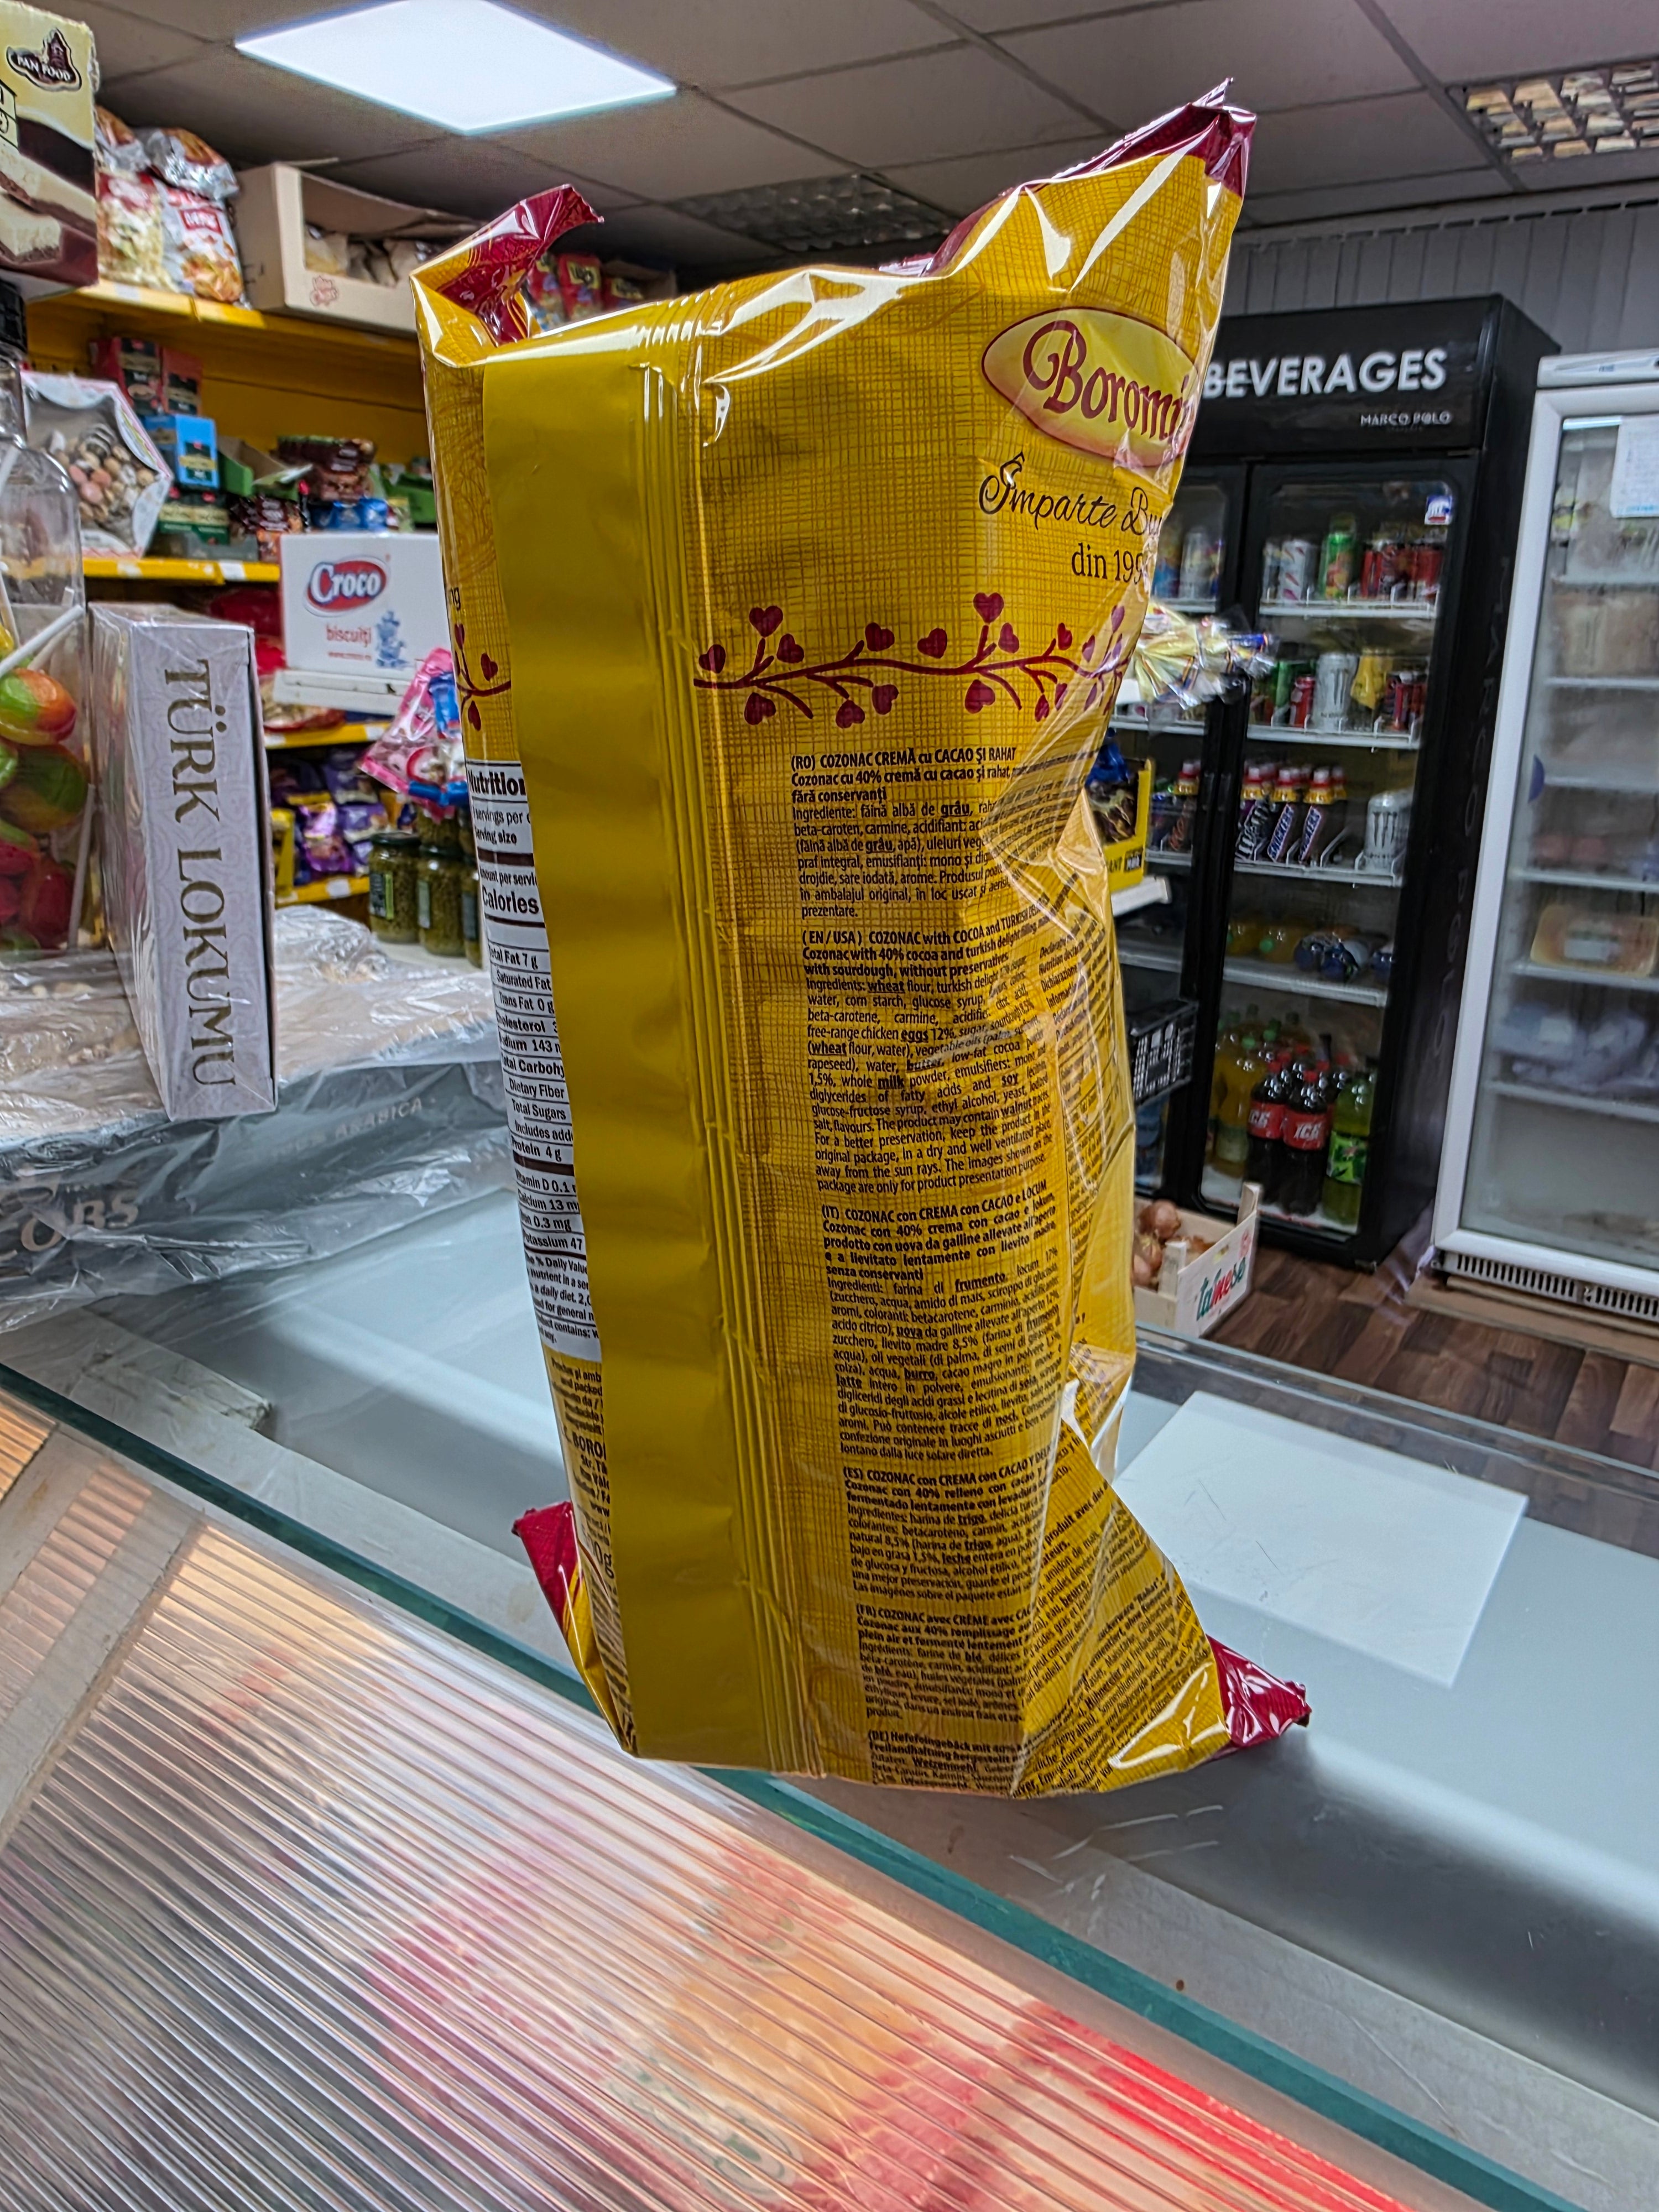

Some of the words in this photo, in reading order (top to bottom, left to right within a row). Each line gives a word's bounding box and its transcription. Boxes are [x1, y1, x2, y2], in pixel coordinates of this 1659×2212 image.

[1203, 348, 1448, 399] BEVERAGES
[1360, 414, 1410, 427] MARCO
[1413, 411, 1453, 425] POLO
[979, 451, 1118, 530] Împarte
[1072, 542, 1108, 579] din
[310, 563, 382, 606] Croco
[164, 659, 227, 824] TÜRK
[791, 754, 815, 771] (RO)
[820, 752, 873, 768] COZONAC
[874, 748, 916, 765] CREMĂ
[917, 753, 932, 764] cu
[934, 748, 973, 763] CACAO
[988, 747, 1016, 760] RAHAT
[791, 773, 838, 786] Cozonac
[840, 774, 853, 785] cu
[855, 769, 881, 784] 40%
[884, 768, 921, 782] cremă
[923, 770, 937, 781] cu
[940, 769, 974, 780] cacao
[791, 789, 816, 803] fără
[506, 812, 523, 825] per
[792, 806, 855, 822] Ingrediente:
[860, 804, 886, 817] făină
[892, 802, 915, 817] albă
[921, 801, 935, 816] de
[940, 800, 973, 820] grâu,
[498, 830, 517, 843] size
[794, 823, 863, 837] beta-caroten,
[864, 821, 910, 834] carmine,
[796, 838, 825, 854] (făină
[827, 838, 849, 852] albă
[851, 837, 863, 851] de
[865, 837, 895, 854] grâu,
[897, 835, 924, 853] apă),
[926, 834, 961, 849] uleiuri
[797, 854, 818, 871] praf
[820, 854, 863, 871] integral,
[929, 855, 962, 867] mono
[499, 873, 511, 886] per
[799, 871, 837, 887] drojdie,
[839, 870, 860, 884] sare
[862, 870, 898, 885] iodată,
[900, 873, 937, 884] arome.
[939, 868, 983, 883] Produsul
[482, 886, 539, 914] Calories
[800, 887, 810, 901] în
[815, 886, 864, 903] ambalajul
[868, 887, 911, 904] original,
[915, 887, 926, 900] în
[931, 886, 947, 900] loc
[951, 886, 977, 900] uscat
[801, 904, 858, 919] prezentare.
[868, 931, 921, 945] COZONAC
[922, 928, 951, 945] with
[952, 925, 983, 943] COCOA
[985, 920, 1000, 935] and
[504, 950, 520, 965] Fat
[521, 953, 528, 966] 7
[531, 956, 538, 969] g
[802, 947, 849, 961] Cozonac
[849, 947, 876, 961] with
[878, 947, 904, 961] 40%
[906, 950, 938, 961] cocoa
[940, 947, 963, 961] and
[966, 939, 996, 958] turkish
[177, 847, 236, 1087] LOKUMU
[804, 963, 830, 975] with
[832, 963, 897, 979] sourdough,
[899, 964, 947, 977] without
[497, 971, 533, 988] Saturated
[534, 977, 551, 990] Fat
[806, 978, 865, 992] Ingredients:
[867, 979, 905, 994] wheat
[907, 978, 934, 994] flour,
[936, 977, 972, 993] turkish
[499, 992, 517, 1008] Trans
[518, 996, 534, 1010] Fat
[537, 998, 545, 1011] 0
[531, 1039, 552, 1053] 143
[509, 1078, 536, 1098] Dietary
[539, 1084, 564, 1098] Fiber
[511, 1096, 530, 1114] Total
[531, 1104, 566, 1120] Sugars
[514, 1120, 550, 1139] Includes
[545, 1143, 552, 1158] 4
[554, 1144, 562, 1162] g
[541, 1178, 549, 1190] D
[551, 1180, 570, 1192] 0.1
[817, 1179, 856, 1194] package
[858, 1183, 874, 1193] are
[876, 1180, 898, 1195] only
[900, 1179, 915, 1191] for
[917, 1175, 957, 1193] product
[958, 1166, 1016, 1188] presentation
[549, 1197, 564, 1211] 13
[821, 1204, 839, 1219] (IT)
[844, 1208, 895, 1223] COZONAC
[896, 1211, 917, 1222] con
[919, 1205, 958, 1219] CREMA
[959, 1204, 979, 1215] con
[981, 1194, 1013, 1212] CACAO
[533, 1213, 551, 1228] 0.3
[552, 1219, 572, 1233] mg
[570, 1237, 582, 1250] 47
[545, 1257, 567, 1271] Daily
[540, 1285, 557, 1300] daily
[560, 1290, 576, 1302] diet.
[545, 1301, 555, 1312] for
[556, 1305, 586, 1319] general
[554, 1319, 591, 1337] contains:
[843, 1467, 863, 1480] (ES)
[867, 1469, 915, 1485] COZONAC
[917, 1475, 936, 1486] con
[938, 1472, 977, 1486] CREMA
[978, 1472, 997, 1483] con
[998, 1459, 1028, 1479] CACAO
